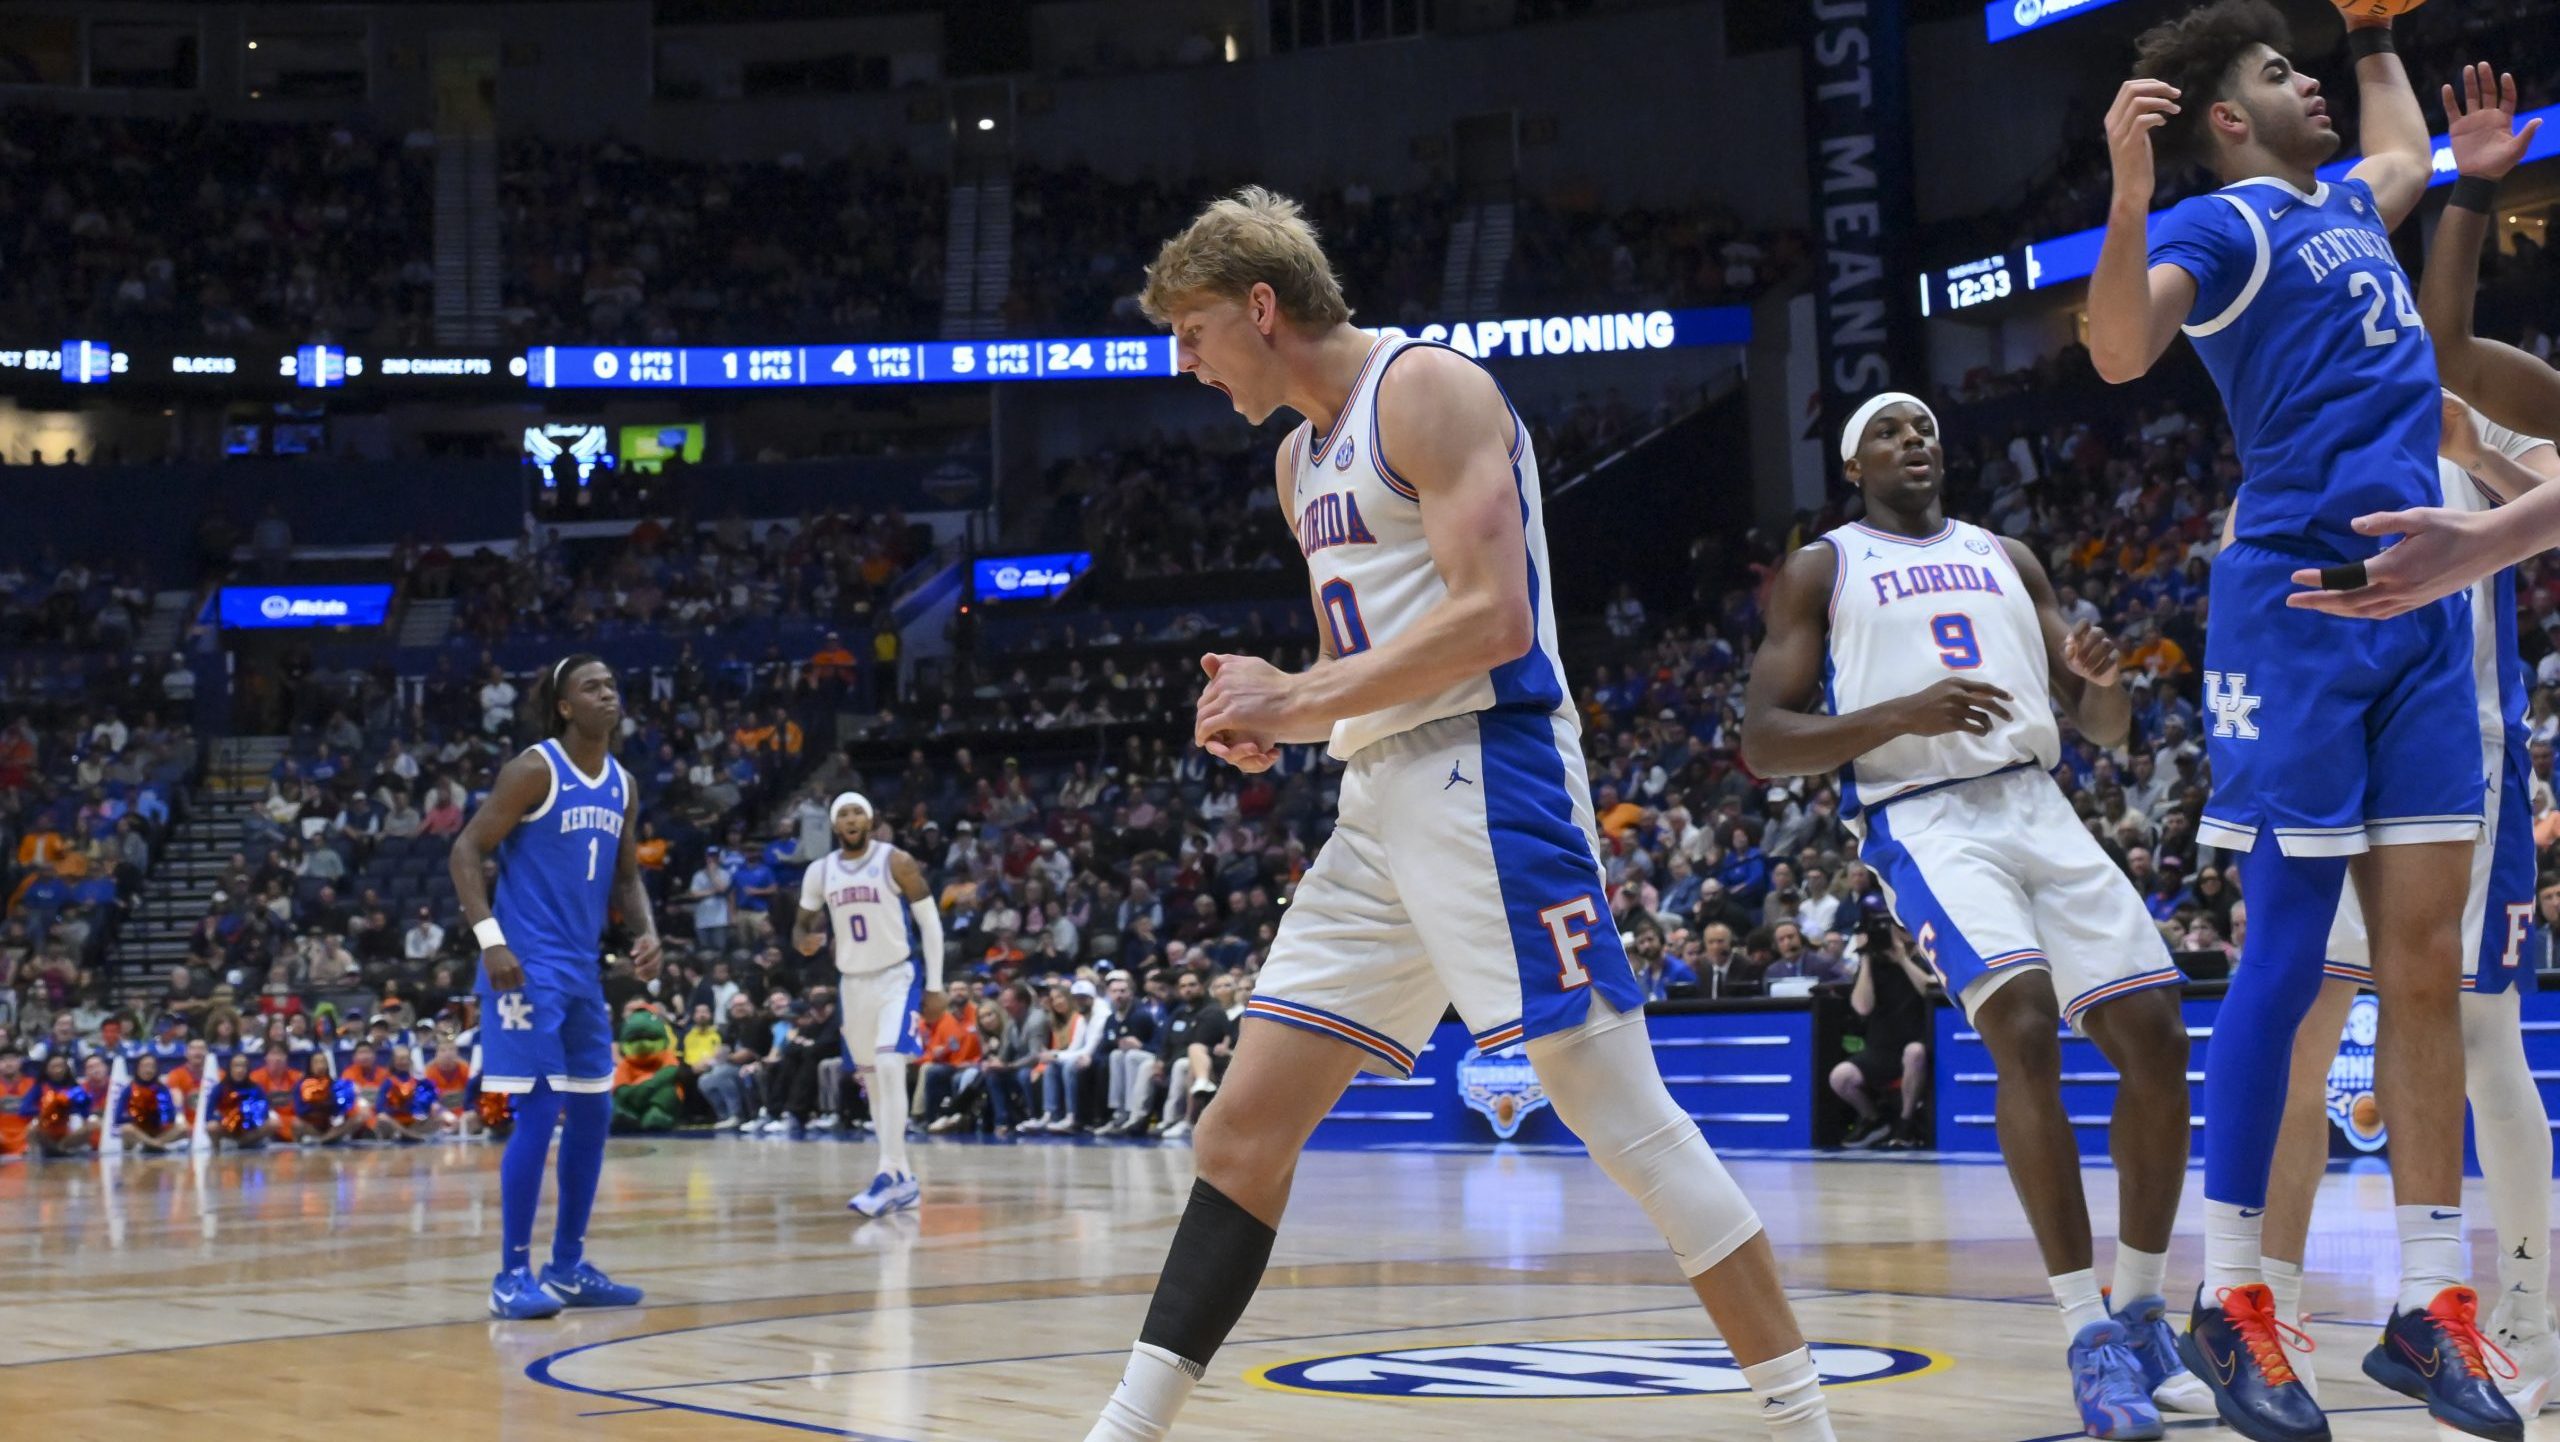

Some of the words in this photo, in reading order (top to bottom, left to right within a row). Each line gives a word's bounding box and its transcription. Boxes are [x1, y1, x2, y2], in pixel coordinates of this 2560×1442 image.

[1820, 134, 1890, 393] MEANS
[1947, 269, 2011, 309] 12:33
[2348, 271, 2425, 347] 24
[642, 351, 673, 366] PTS
[761, 351, 792, 365] PTS
[880, 348, 911, 362] PTS
[952, 346, 975, 373] 5
[998, 344, 1030, 358] PTS
[1048, 343, 1094, 370] 24
[1117, 341, 1148, 355] PTS
[111, 352, 129, 373] 2
[172, 356, 236, 374] BLOCKS
[280, 356, 297, 376] 2
[345, 356, 362, 376] 5
[411, 358, 463, 374] CHANCE
[463, 358, 491, 374] PTS
[509, 356, 527, 376] 0
[593, 352, 619, 379] 0
[642, 366, 673, 380] FLS
[722, 352, 738, 379] 1
[761, 365, 792, 380] FLS
[831, 349, 857, 376] 4
[881, 363, 911, 377] FLS
[999, 359, 1030, 374] FLS
[1117, 356, 1149, 370] FLS
[1870, 563, 2004, 607] FLORIDA
[1321, 577, 1372, 658] 0
[1929, 612, 1984, 671] 9
[560, 805, 625, 838] KENTUCKY
[586, 837, 599, 881] 1
[850, 914, 867, 942] 0
[2502, 903, 2534, 967] F
[1538, 895, 1599, 992] F
